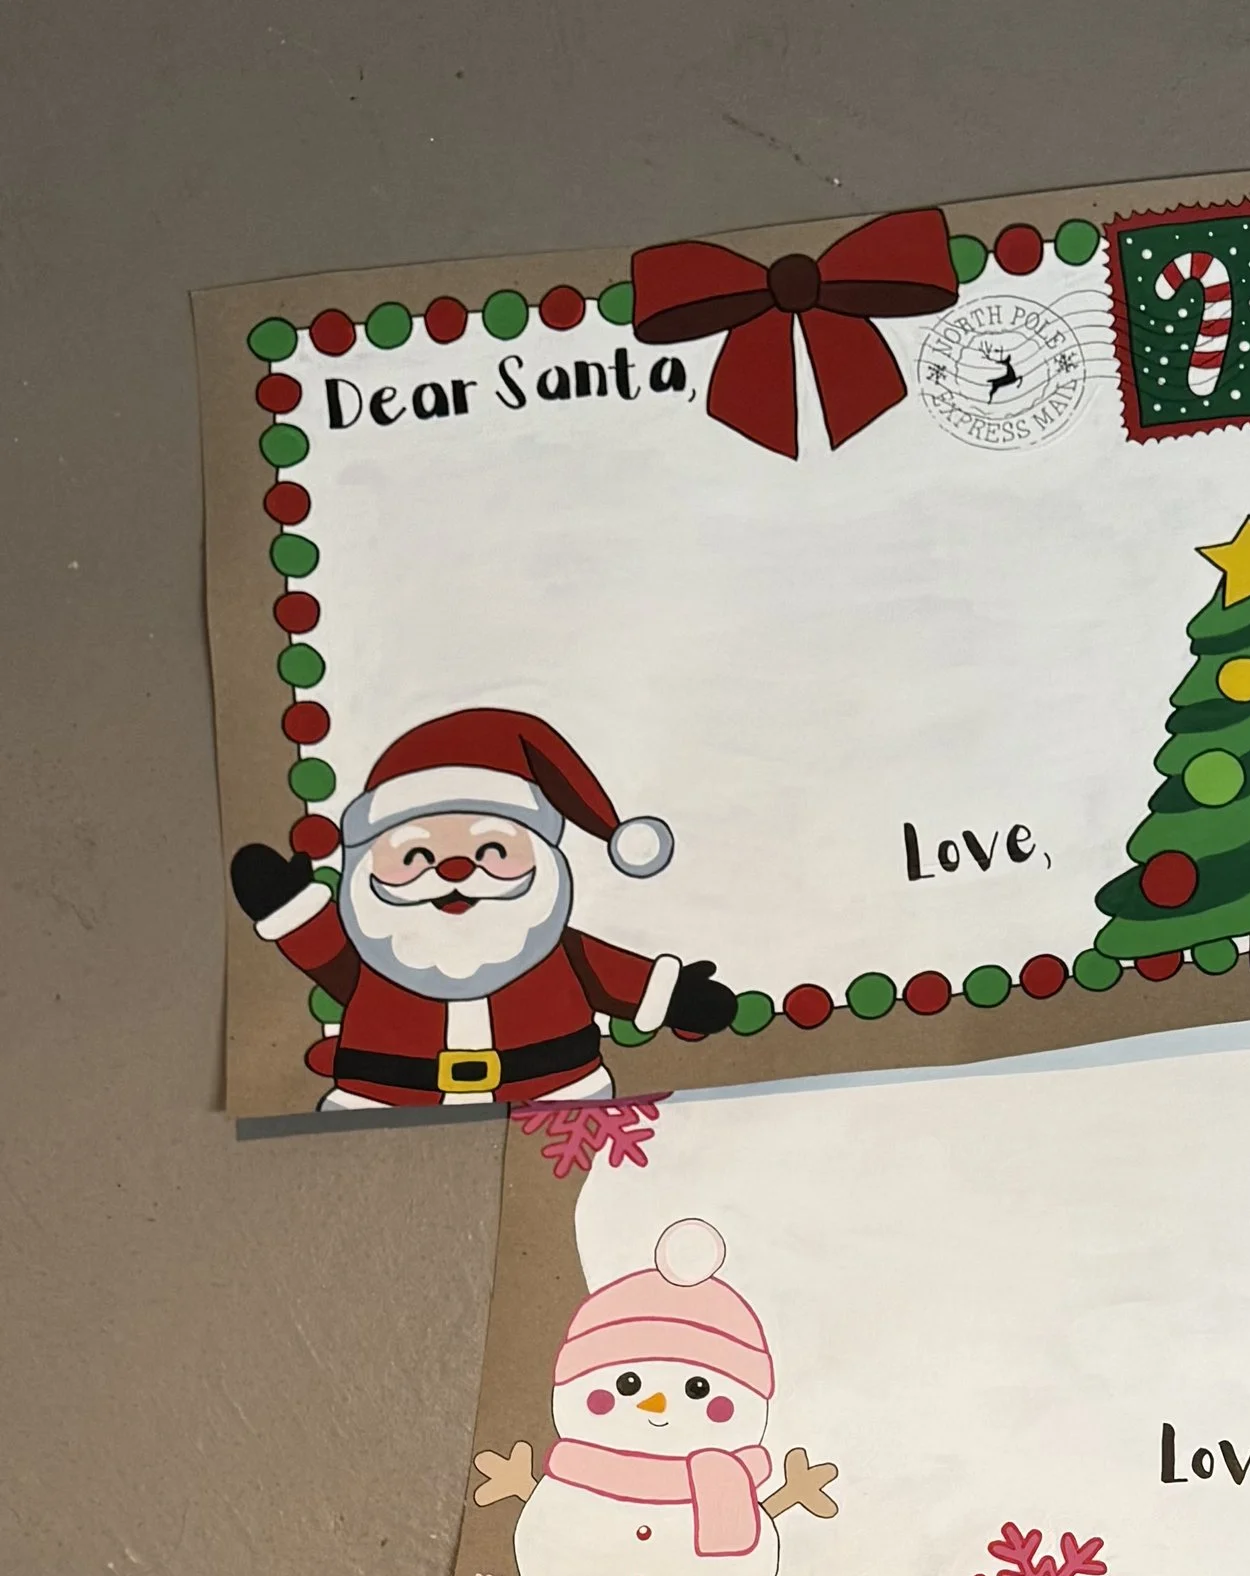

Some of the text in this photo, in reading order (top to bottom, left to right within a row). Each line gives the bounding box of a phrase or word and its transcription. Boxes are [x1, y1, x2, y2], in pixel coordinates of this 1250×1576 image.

[932, 305, 1066, 358] NORTH POLE
[324, 347, 697, 430] Dear Santa,
[932, 379, 1078, 443] EXPRESS MAIL
[903, 822, 1052, 881] Love,
